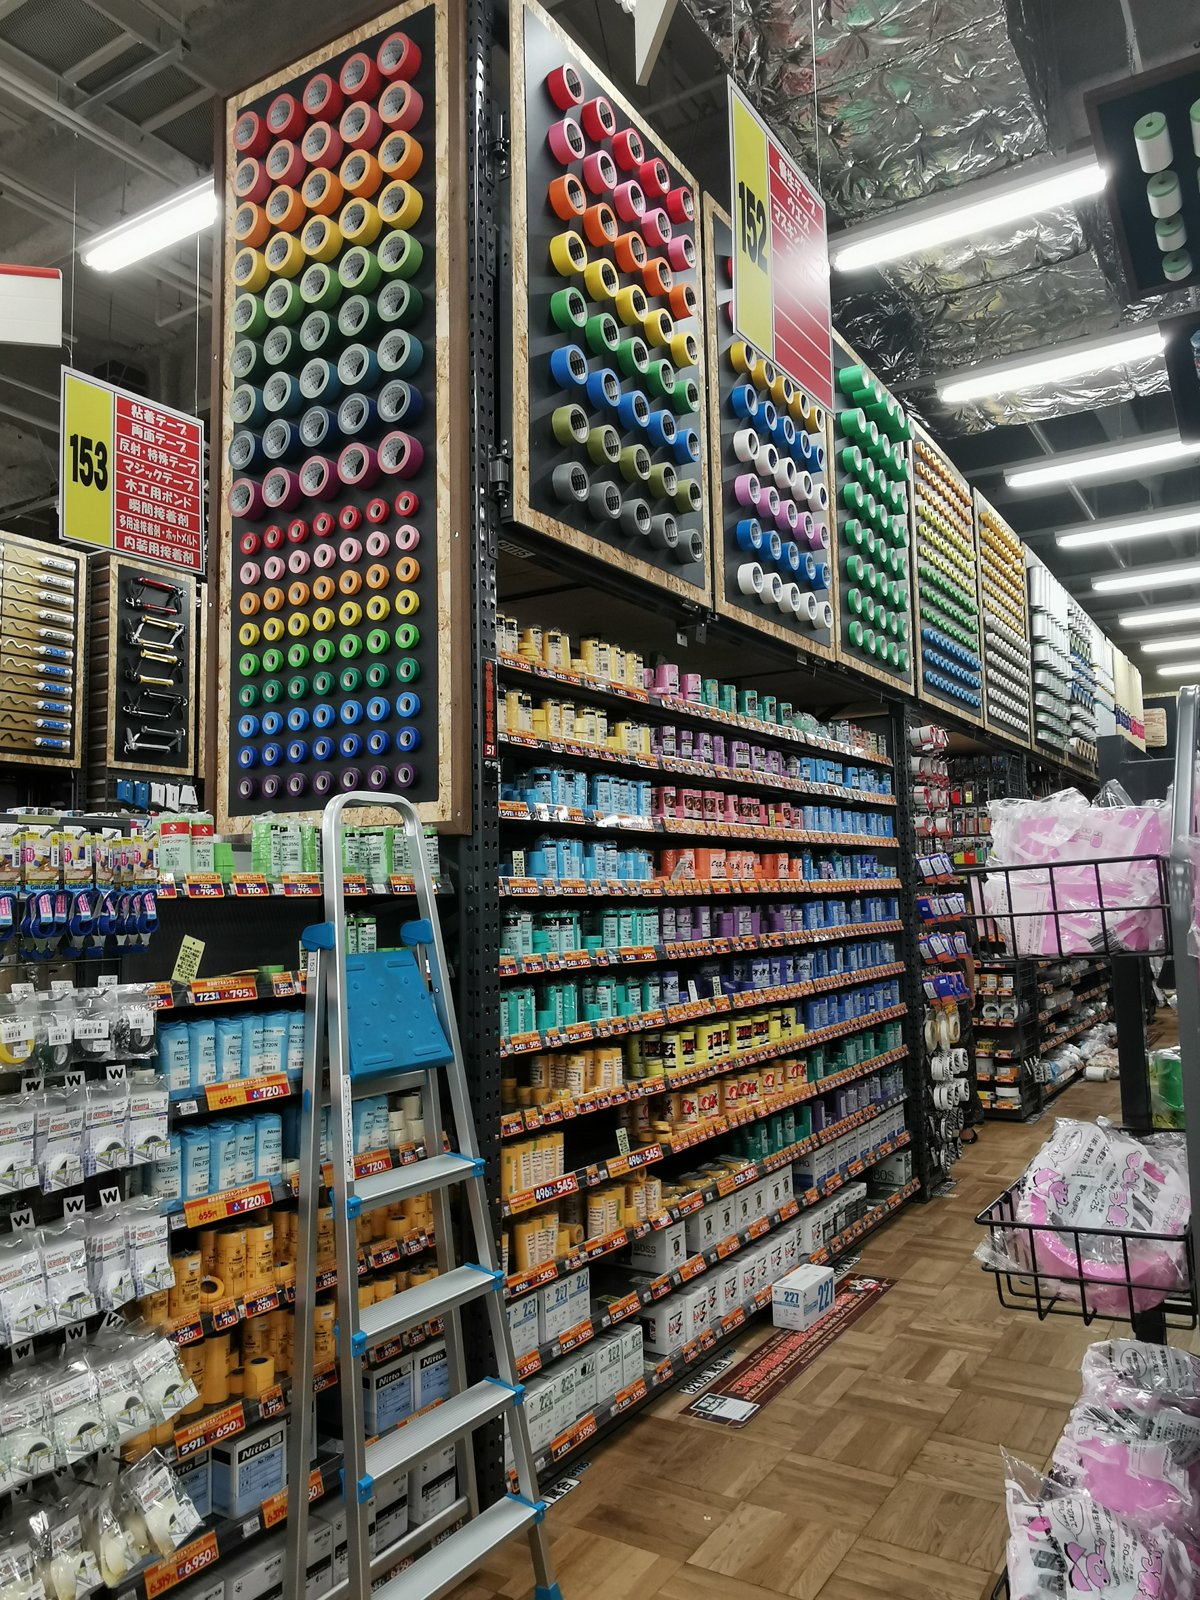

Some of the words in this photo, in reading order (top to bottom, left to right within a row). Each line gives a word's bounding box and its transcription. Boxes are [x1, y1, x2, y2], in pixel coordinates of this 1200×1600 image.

[787, 196, 810, 234] ウエス
[739, 181, 768, 275] 152
[131, 405, 187, 436] 粘着テープ
[131, 423, 187, 454] 両面テープ
[70, 434, 108, 491] 153
[119, 438, 197, 475] 反射・特殊テープ
[122, 460, 194, 492] マジックテープ
[125, 479, 192, 509] 木工用ボンド
[128, 499, 189, 528] 瞬間接着剤
[123, 535, 194, 565] 内装用接着剤
[486, 745, 495, 755] 51
[67, 1075, 82, 1086] W
[109, 1068, 124, 1080] W
[26, 1081, 41, 1092] W
[66, 1199, 84, 1212] W
[103, 1189, 118, 1203] W
[13, 1213, 31, 1227] W
[784, 1291, 799, 1303] 227
[818, 1277, 834, 1313] 227
[523, 1298, 536, 1317] 227
[67, 1326, 84, 1339] W
[15, 1344, 31, 1357] W
[423, 1353, 444, 1367] Nitto
[378, 1372, 400, 1387] Nitto
[241, 1441, 270, 1460] Nitto
